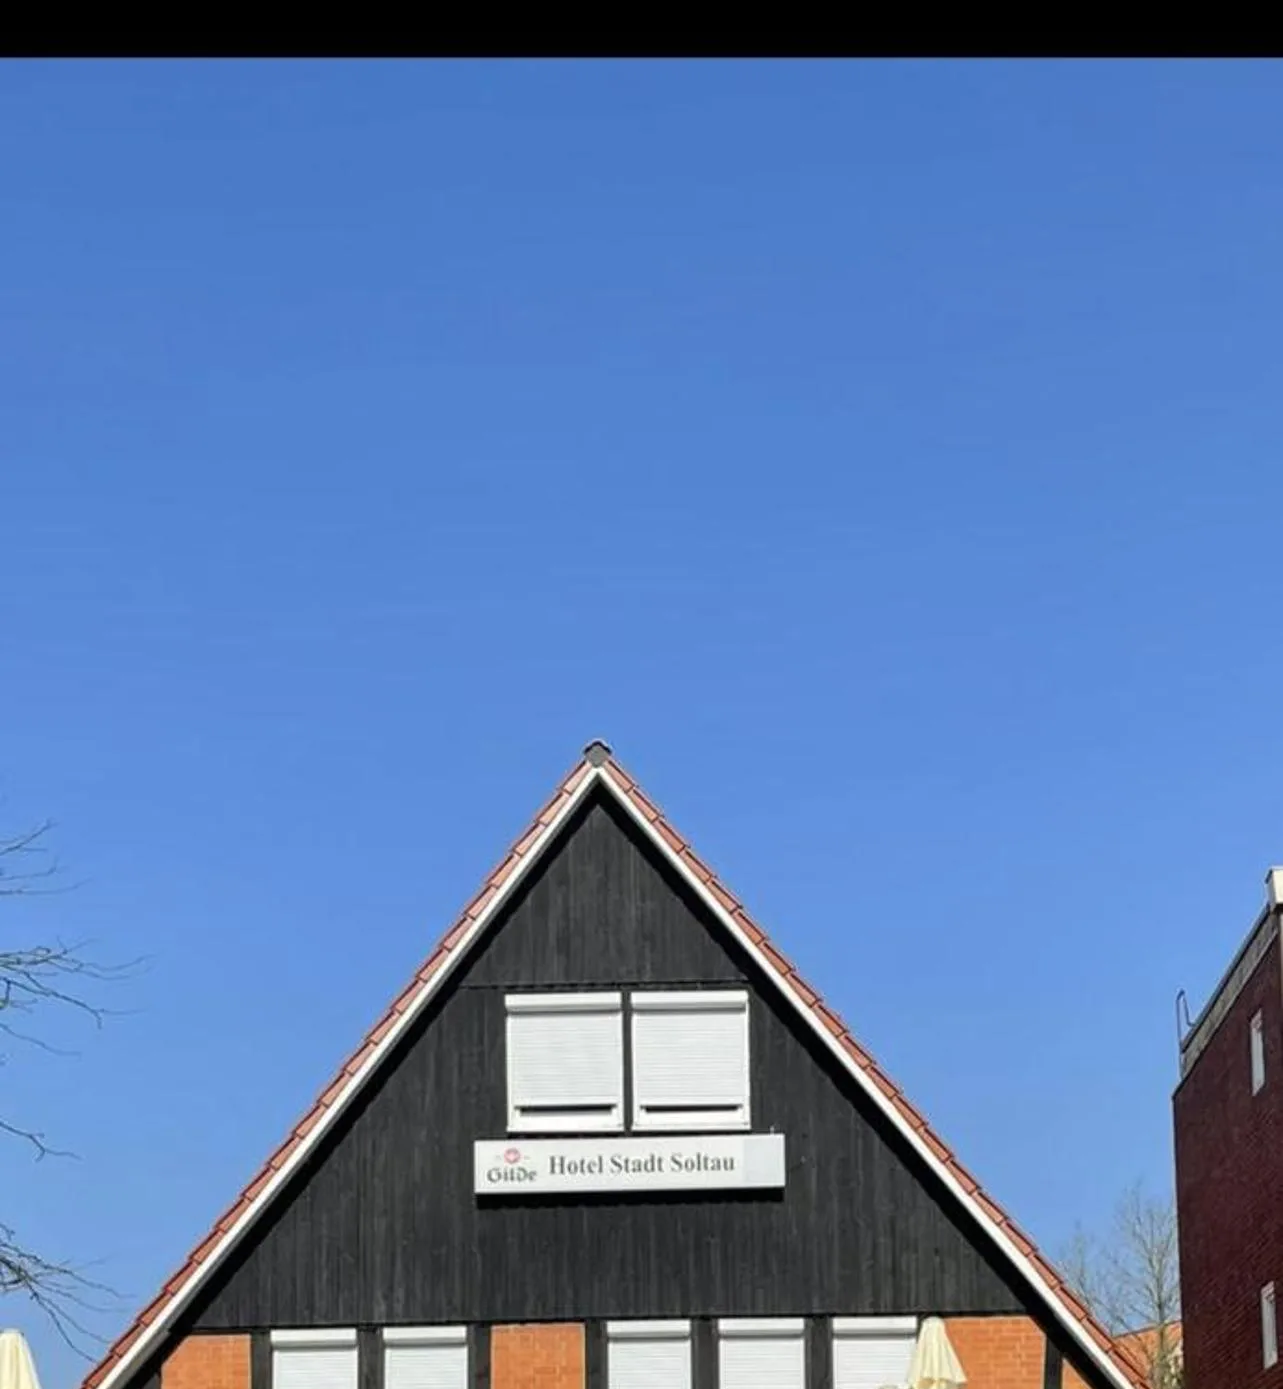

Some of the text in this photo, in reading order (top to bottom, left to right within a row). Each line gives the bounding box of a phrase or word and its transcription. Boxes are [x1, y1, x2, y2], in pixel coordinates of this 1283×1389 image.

[549, 1151, 736, 1175] Hotel Stadt Soltau
